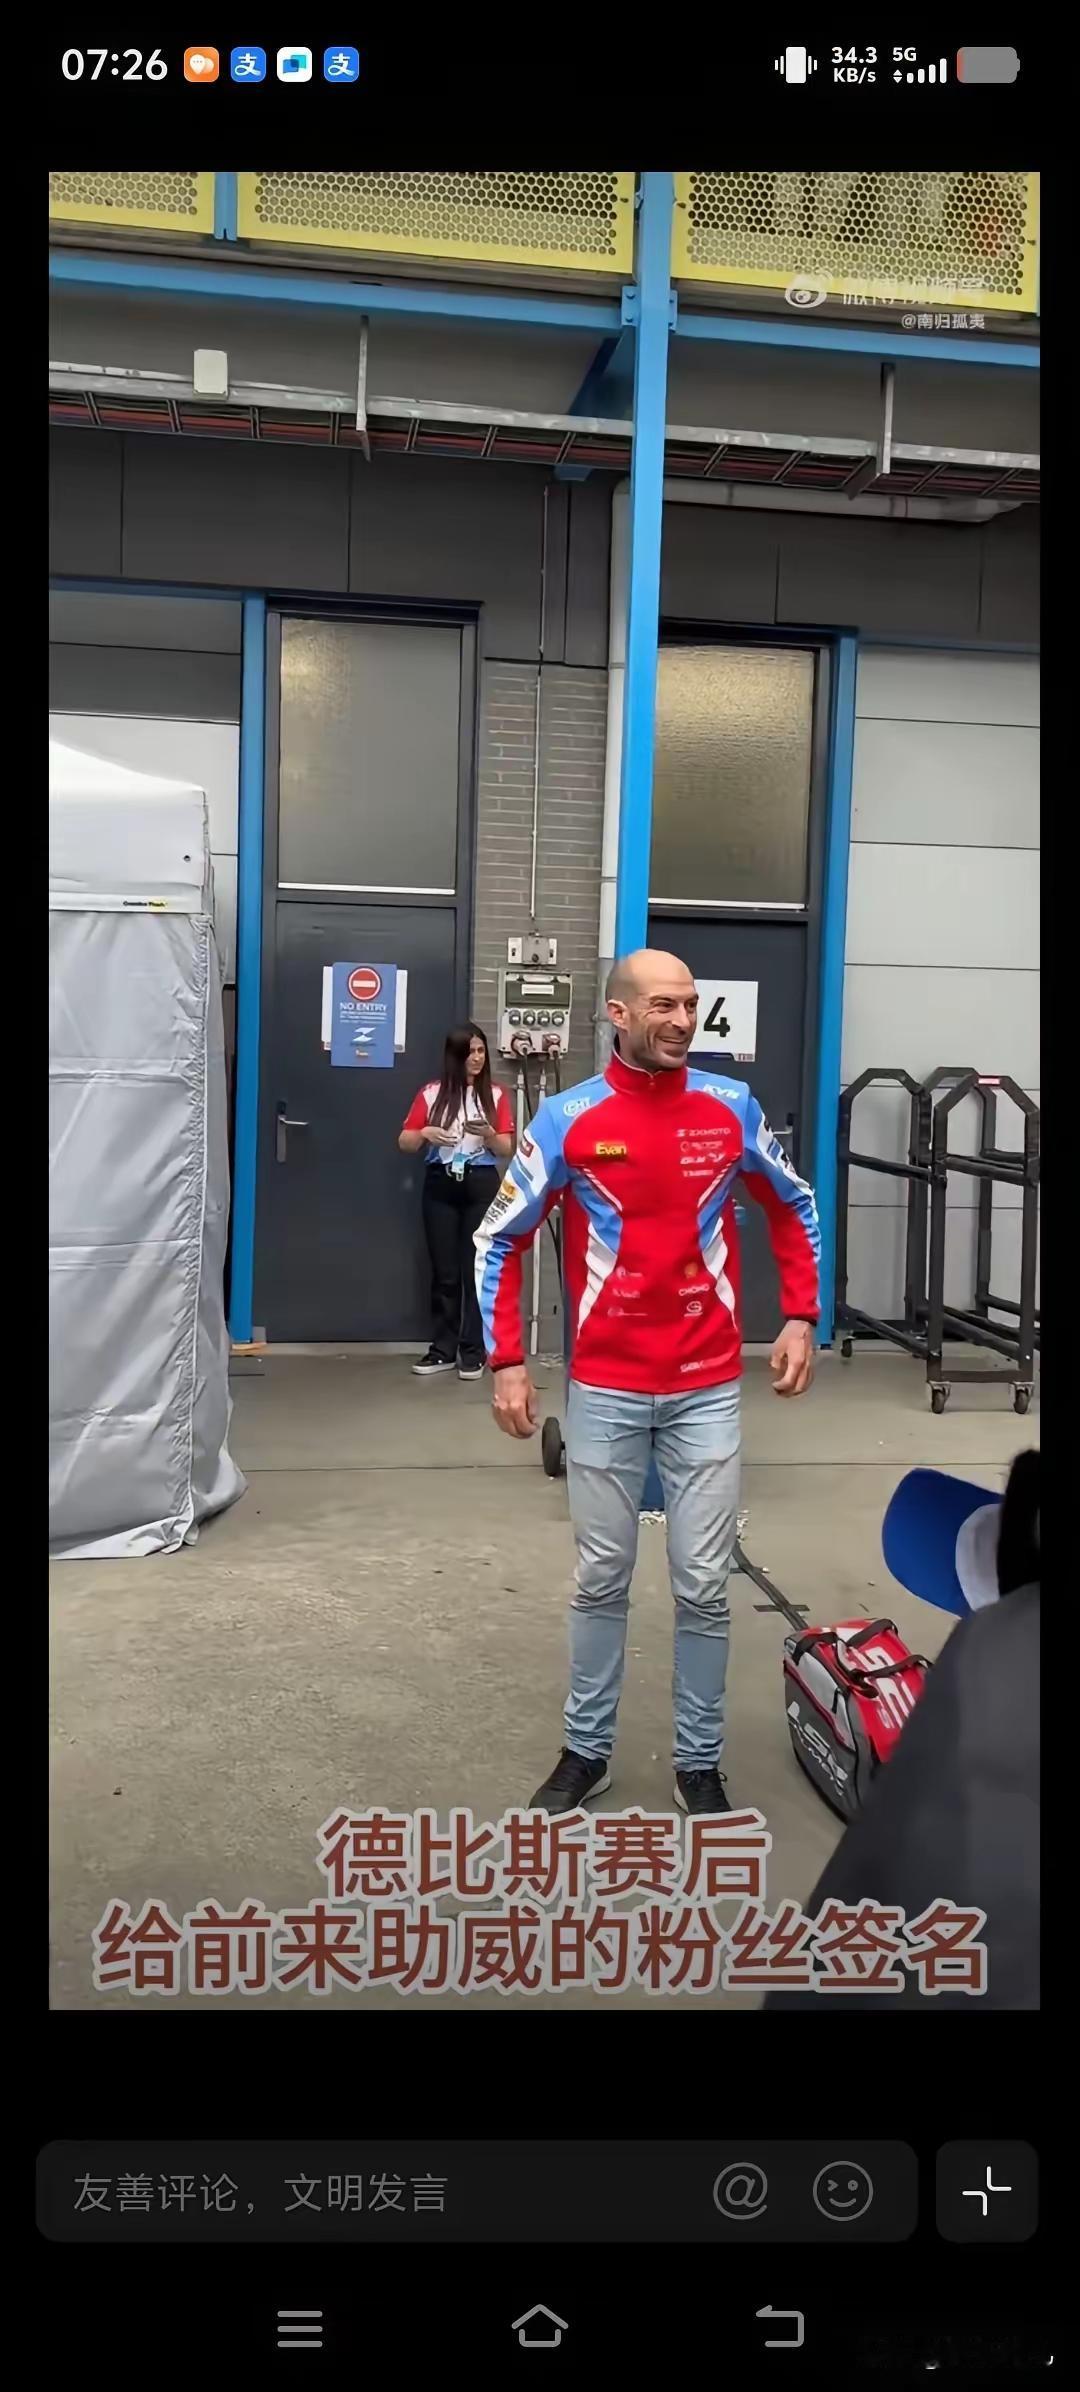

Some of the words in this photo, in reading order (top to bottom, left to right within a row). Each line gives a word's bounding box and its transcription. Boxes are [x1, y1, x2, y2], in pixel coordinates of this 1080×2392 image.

[831, 46, 878, 64] 34.3
[892, 46, 917, 62] 5G
[61, 48, 168, 81] 07:26
[833, 67, 877, 85] KB/s
[339, 1002, 354, 1010] NO
[355, 1002, 387, 1012] ENTRY
[703, 996, 731, 1038] 4
[595, 1142, 627, 1156] Evan
[73, 2172, 449, 2215] 友善评论，文明发言
